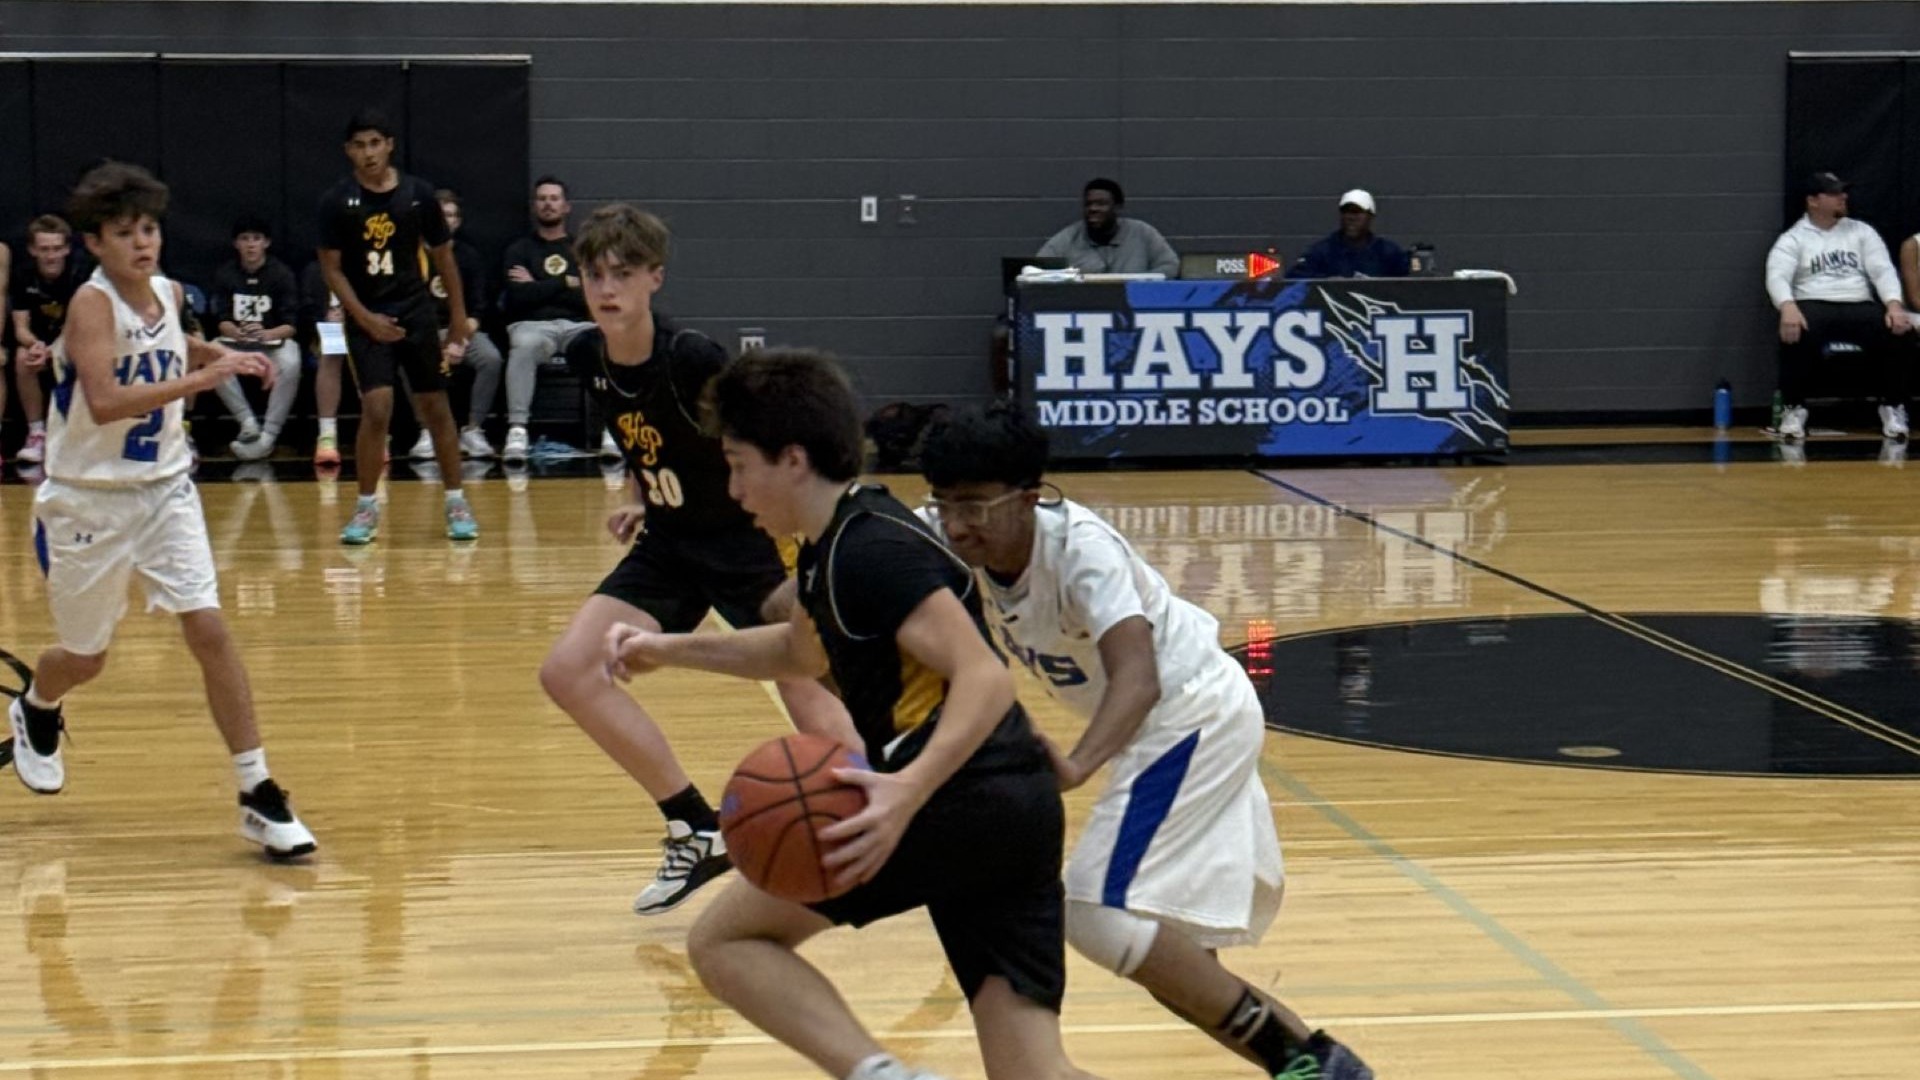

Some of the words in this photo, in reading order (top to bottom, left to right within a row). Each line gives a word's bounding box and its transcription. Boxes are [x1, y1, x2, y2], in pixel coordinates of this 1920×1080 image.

[367, 251, 394, 275] 34
[1034, 310, 1326, 390] HAYS
[1373, 316, 1468, 410] H
[121, 406, 165, 462] 2
[1037, 399, 1191, 426] MIDDLE
[1197, 397, 1349, 425] SCHOOL
